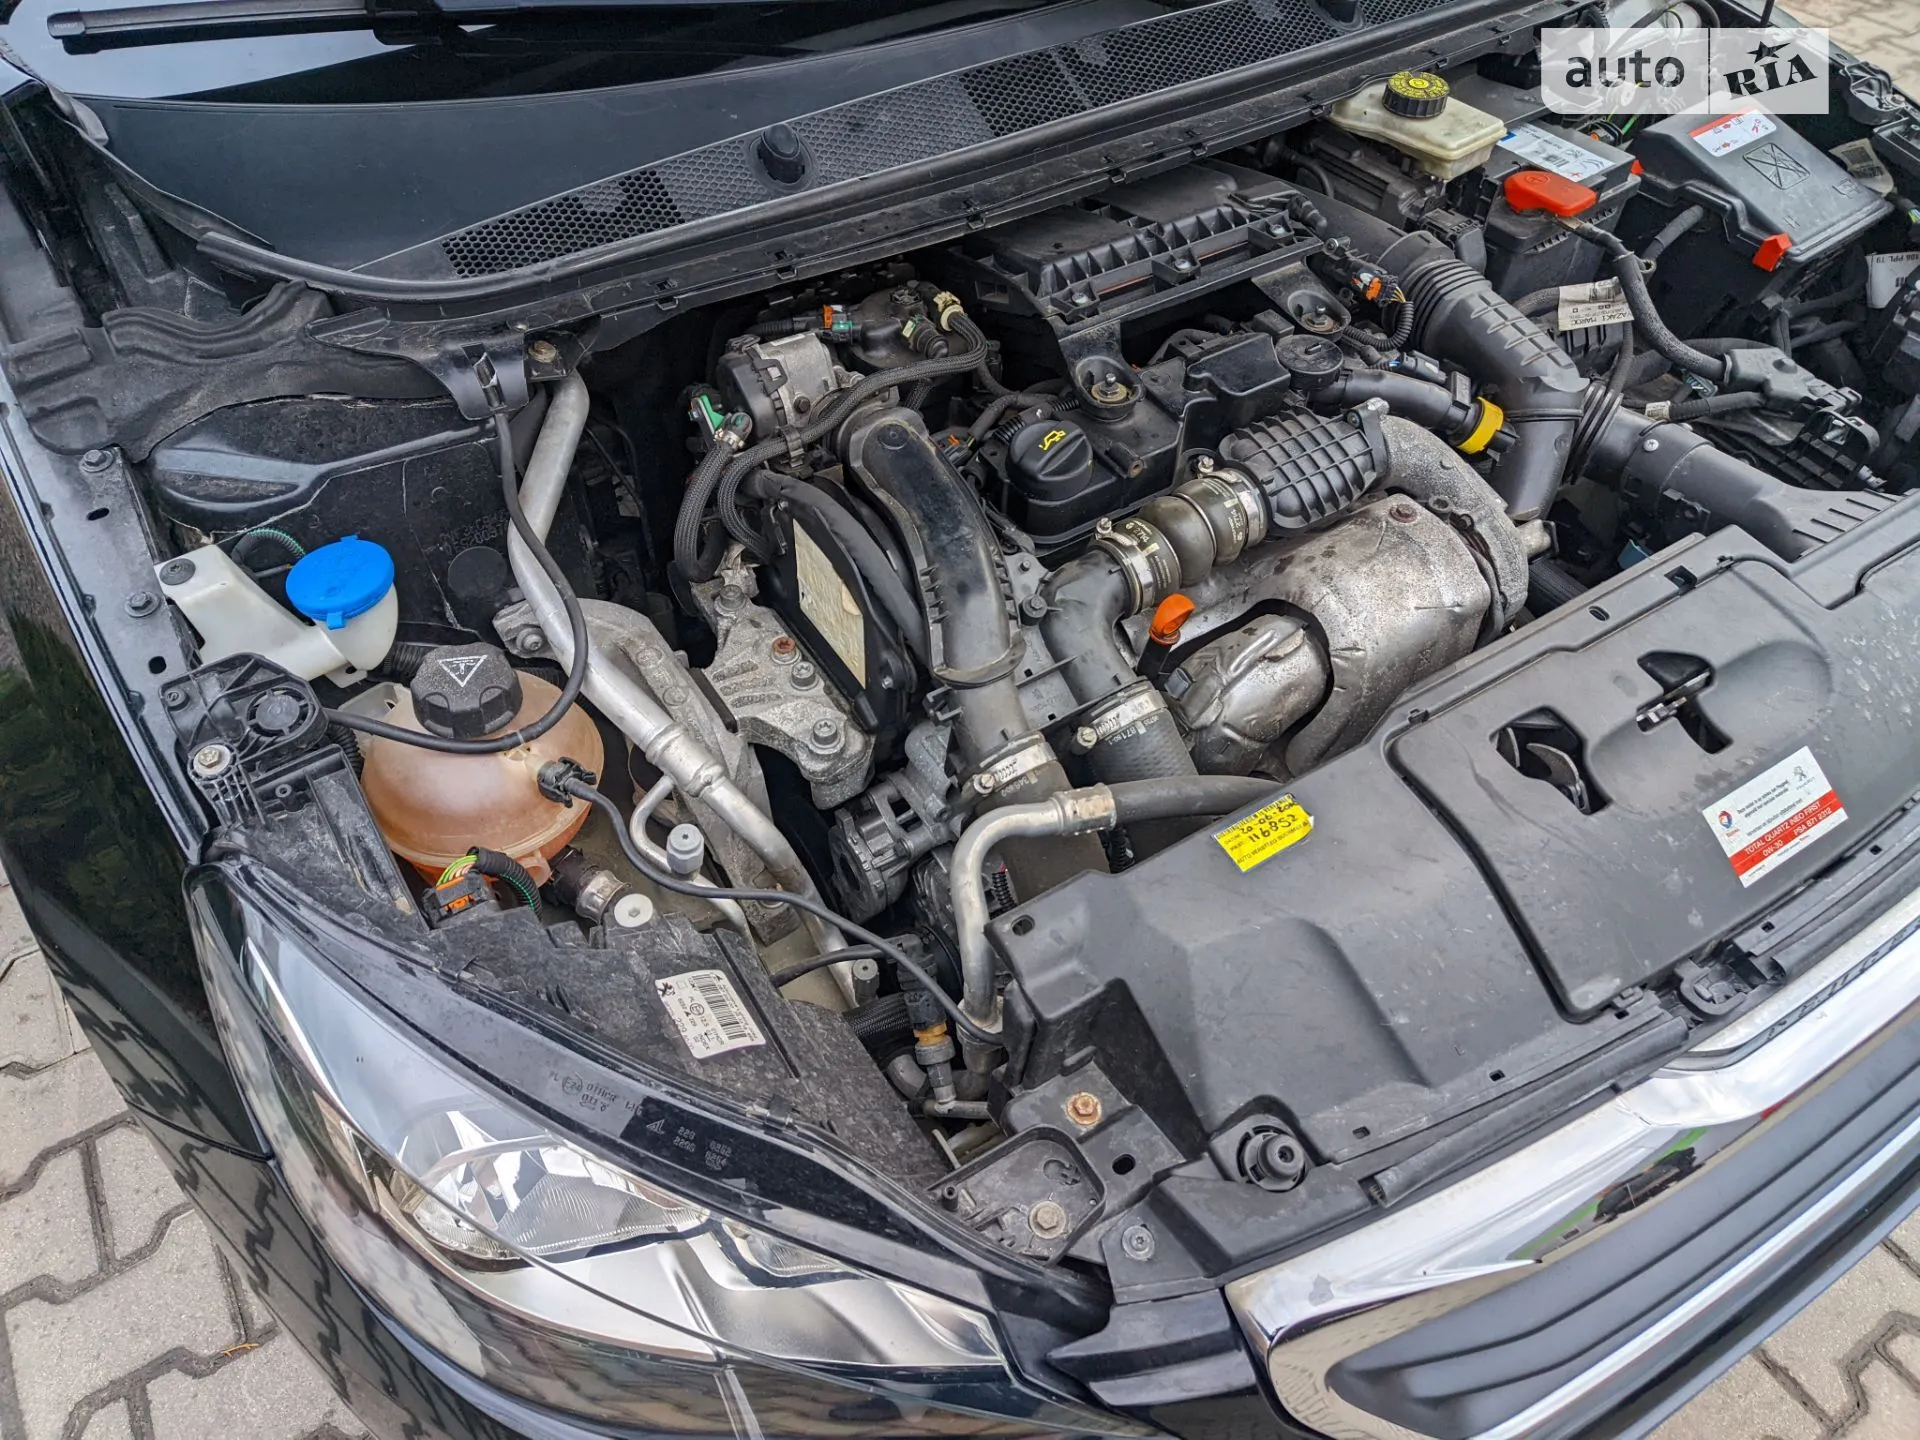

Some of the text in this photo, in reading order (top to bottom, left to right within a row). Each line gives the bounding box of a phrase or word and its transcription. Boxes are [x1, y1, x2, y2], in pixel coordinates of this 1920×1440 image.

[1745, 840, 1766, 855] TOTAL
[1766, 824, 1790, 843] QUARTZ
[1790, 812, 1804, 828] INEO
[1804, 801, 1821, 819] FIRST
[1793, 825, 1807, 837] PSA
[1818, 807, 1833, 823] 2312
